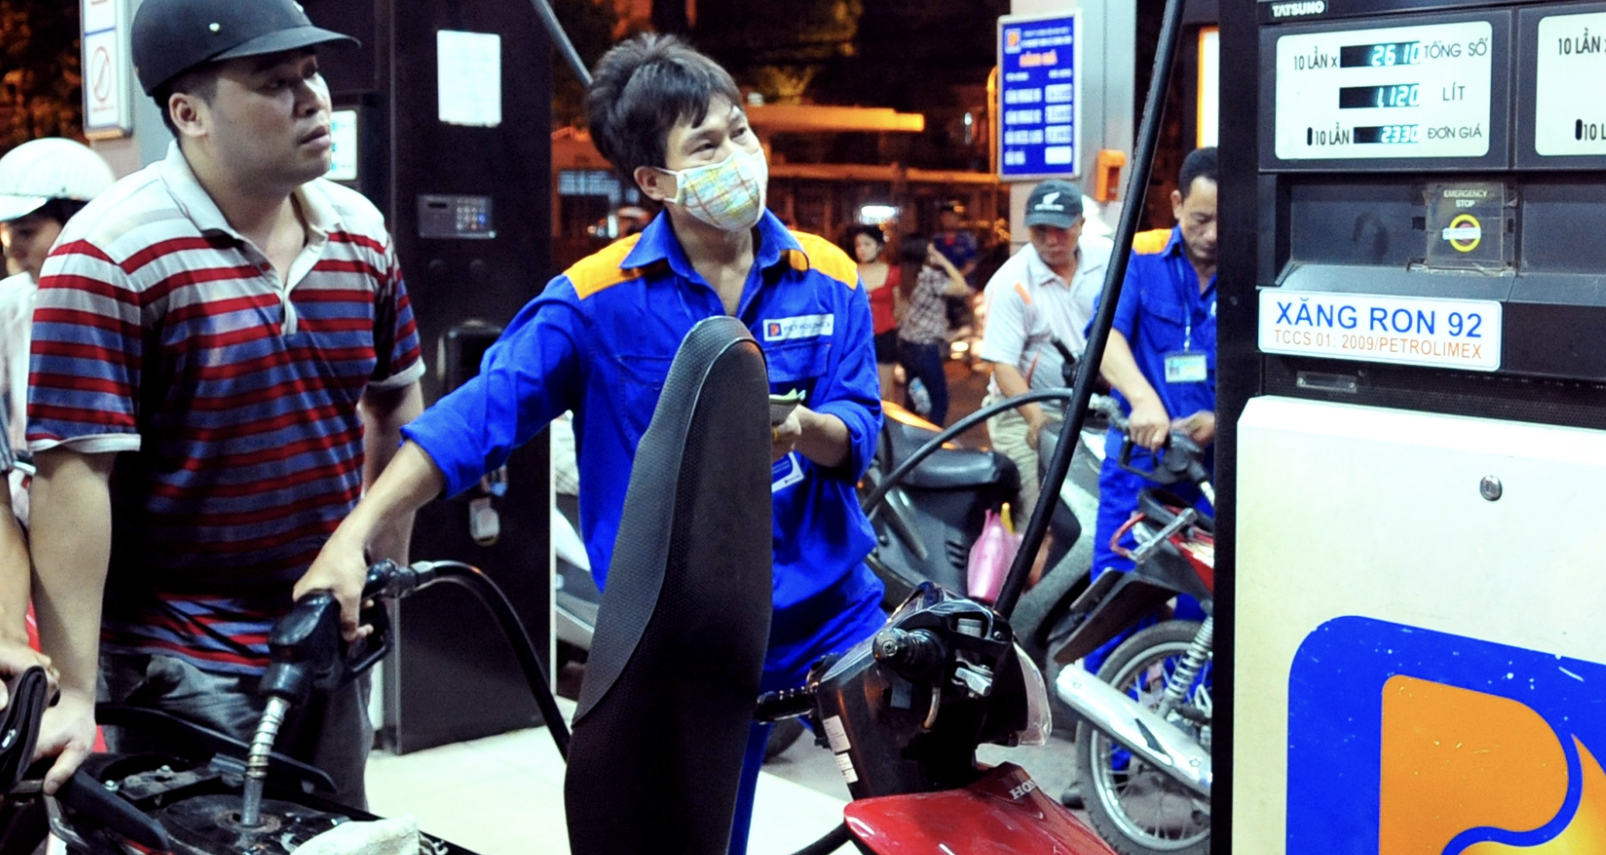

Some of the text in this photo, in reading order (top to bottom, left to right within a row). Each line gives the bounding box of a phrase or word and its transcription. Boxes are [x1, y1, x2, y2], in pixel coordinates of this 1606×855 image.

[1272, 0, 1325, 17] TATSUNO
[1558, 37, 1572, 55] 10
[1294, 55, 1305, 71] 10
[1370, 42, 1420, 67] 2610
[1442, 81, 1466, 101] LÍT
[1315, 130, 1326, 146] 10
[1583, 123, 1597, 141] 10
[1443, 189, 1488, 198] EMERGENCY
[1455, 199, 1476, 208] STOP
[1275, 296, 1483, 339] XĂNG RON 92
[1274, 329, 1312, 346] TCCS
[1341, 334, 1483, 360] 2009/PETROLIMEX
